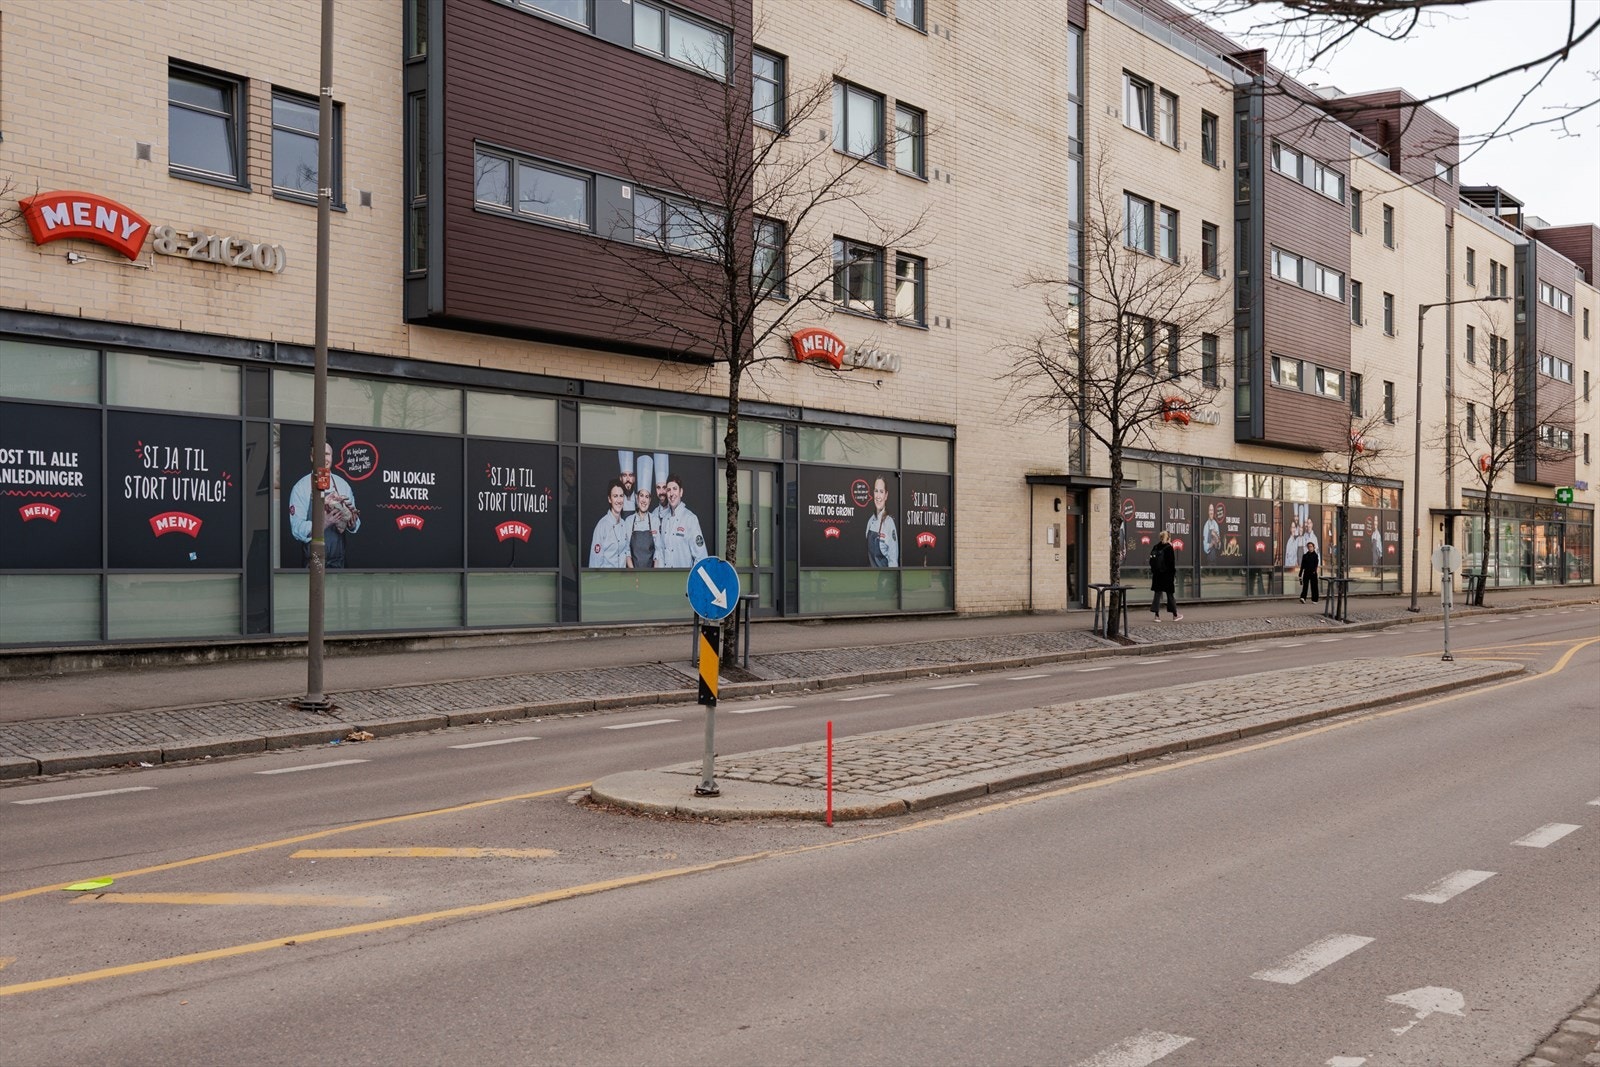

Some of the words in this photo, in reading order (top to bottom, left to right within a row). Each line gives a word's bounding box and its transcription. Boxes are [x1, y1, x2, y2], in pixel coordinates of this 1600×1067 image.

[41, 202, 140, 240] MENY
[153, 225, 286, 274] 8-21(20)
[802, 334, 843, 357] MENY
[0, 448, 24, 464] OST
[27, 450, 47, 466] TIL
[51, 451, 78, 467] ALLE
[143, 445, 159, 469] SI
[164, 447, 179, 470] JA
[184, 447, 209, 472] TIL
[383, 469, 401, 484] DIN
[403, 471, 436, 485] LOKALE
[491, 466, 502, 486] SI
[504, 468, 516, 487] JA
[519, 467, 536, 488] TIL
[124, 475, 168, 500] STORT
[172, 478, 226, 502] UTVALG!
[390, 487, 429, 501] SLAKTER
[478, 491, 508, 512] STORT
[510, 493, 548, 513] UTVALG!
[817, 493, 838, 504] STØRST
[838, 493, 846, 505] PÅ
[913, 492, 921, 507] SI
[921, 493, 928, 507] JA
[929, 493, 939, 508] TIL
[24, 506, 57, 518] MENY
[808, 505, 826, 516] FRUKT
[826, 506, 835, 516] OG
[835, 506, 855, 517] GRØNT
[906, 510, 924, 526] STORT
[924, 511, 946, 527] UTVALG!
[156, 516, 198, 531] MENY
[399, 517, 422, 527] MENY
[499, 524, 528, 537] MENY
[918, 534, 935, 544] MENY
